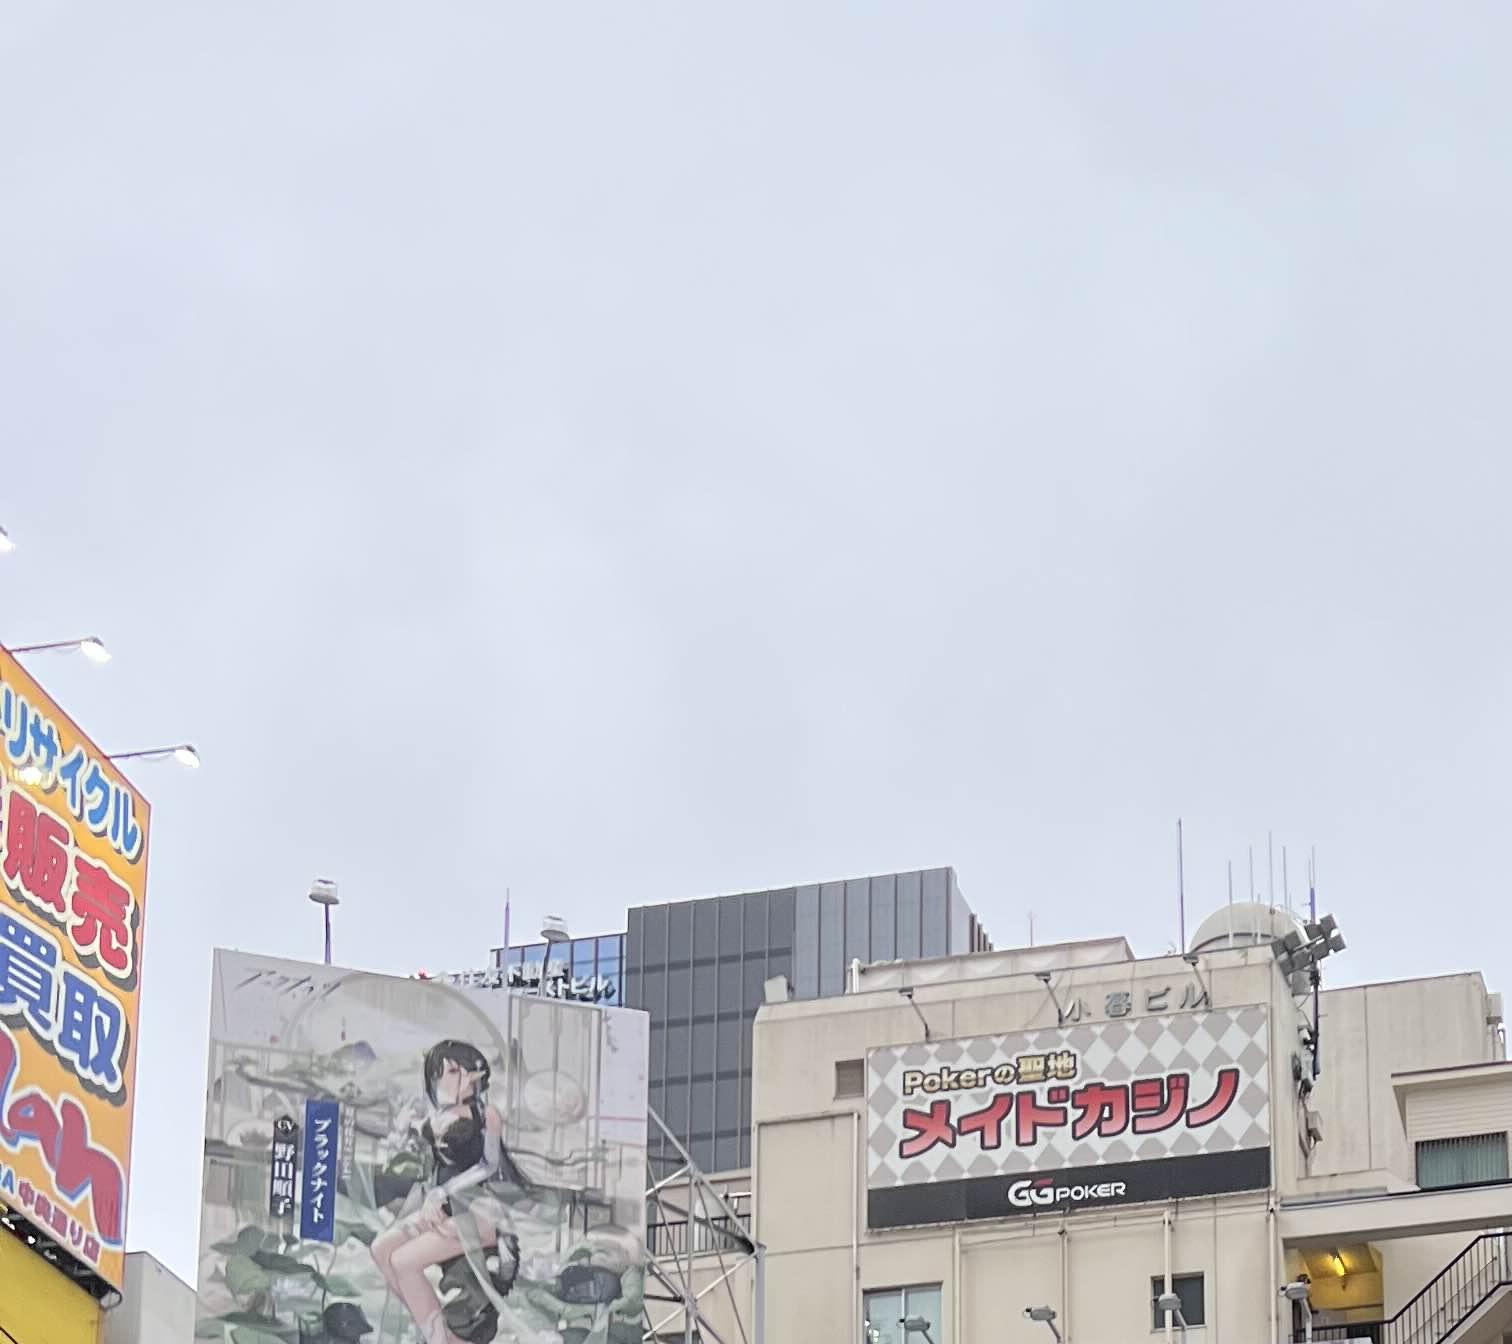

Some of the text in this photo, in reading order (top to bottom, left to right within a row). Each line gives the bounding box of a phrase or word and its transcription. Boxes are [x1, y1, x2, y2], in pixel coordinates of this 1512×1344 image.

[4, 687, 138, 854] リサイクル
[4, 789, 131, 969] 販売
[0, 908, 121, 1084] 買取
[901, 1069, 1240, 1159] メイドカジノ
[903, 1051, 1077, 1095] Pokerの聖地
[310, 1118, 332, 1223] ブラックナイト
